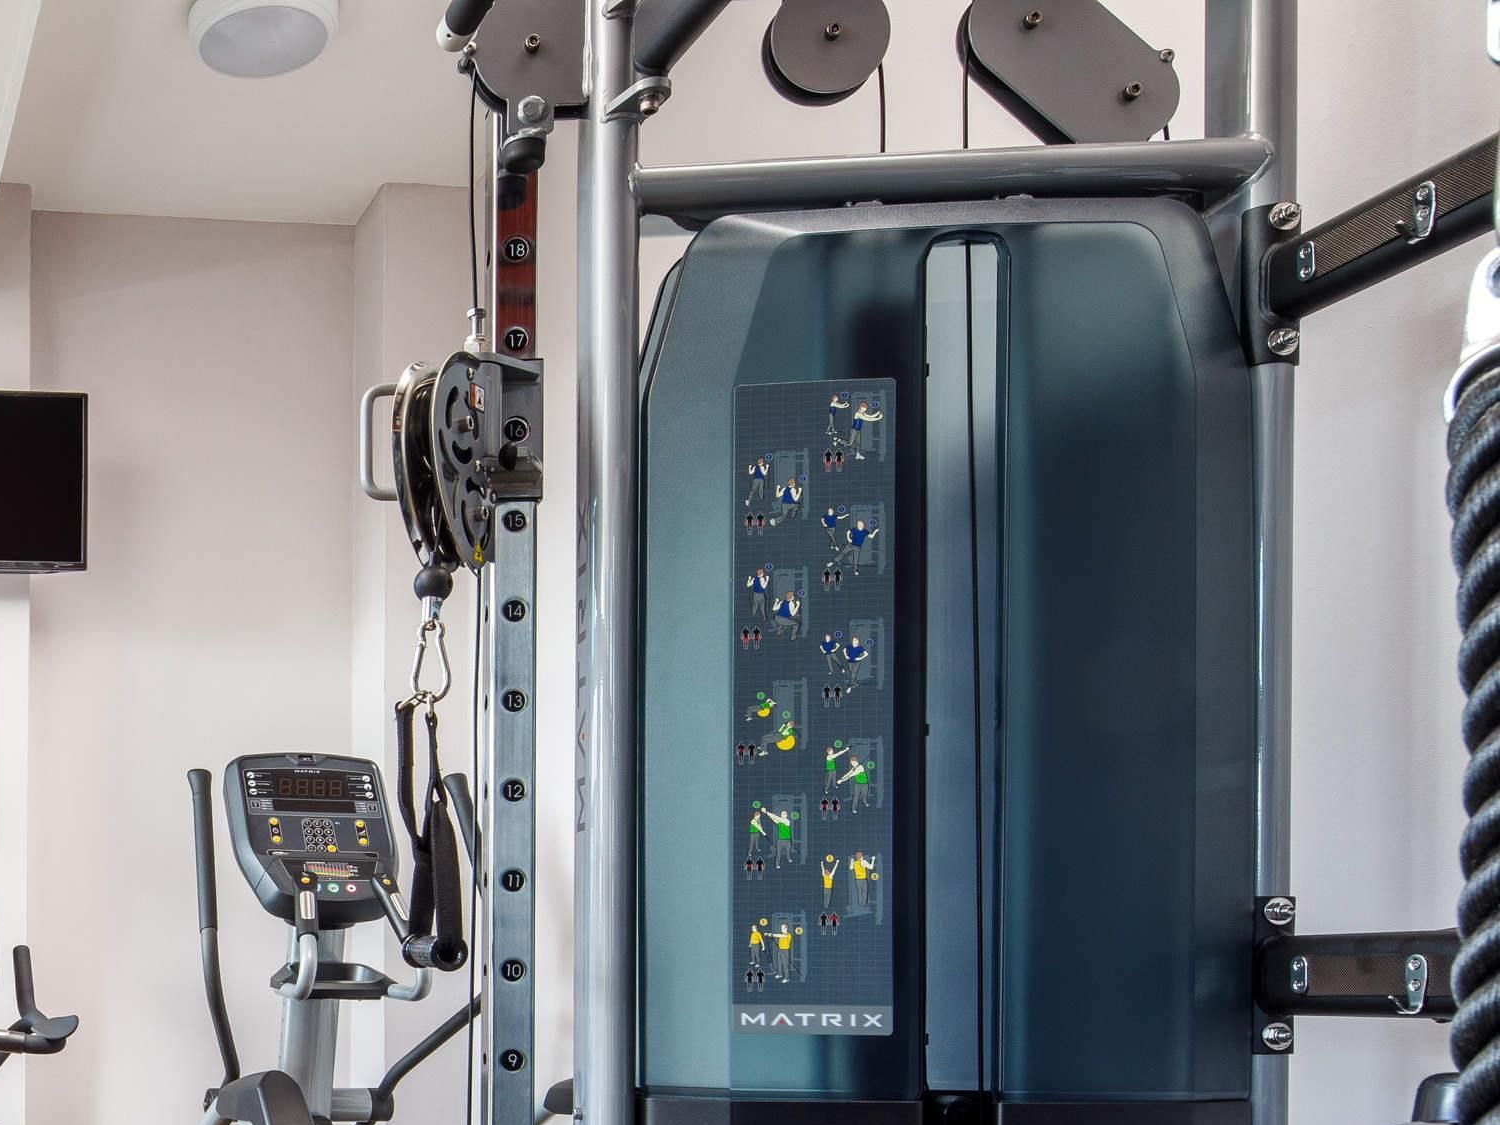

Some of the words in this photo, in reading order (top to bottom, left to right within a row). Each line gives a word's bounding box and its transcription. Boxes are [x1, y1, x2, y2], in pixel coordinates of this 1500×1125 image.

[510, 244, 525, 257] 18
[510, 334, 525, 348] 17
[511, 424, 526, 438] 16
[508, 514, 524, 528] 15
[507, 604, 522, 618] 14
[507, 694, 522, 708] 13
[507, 784, 523, 798] 12
[507, 874, 520, 888] 11
[506, 964, 522, 978] 10
[740, 1012, 883, 1028] MATRIX
[508, 1053, 518, 1067] 9
